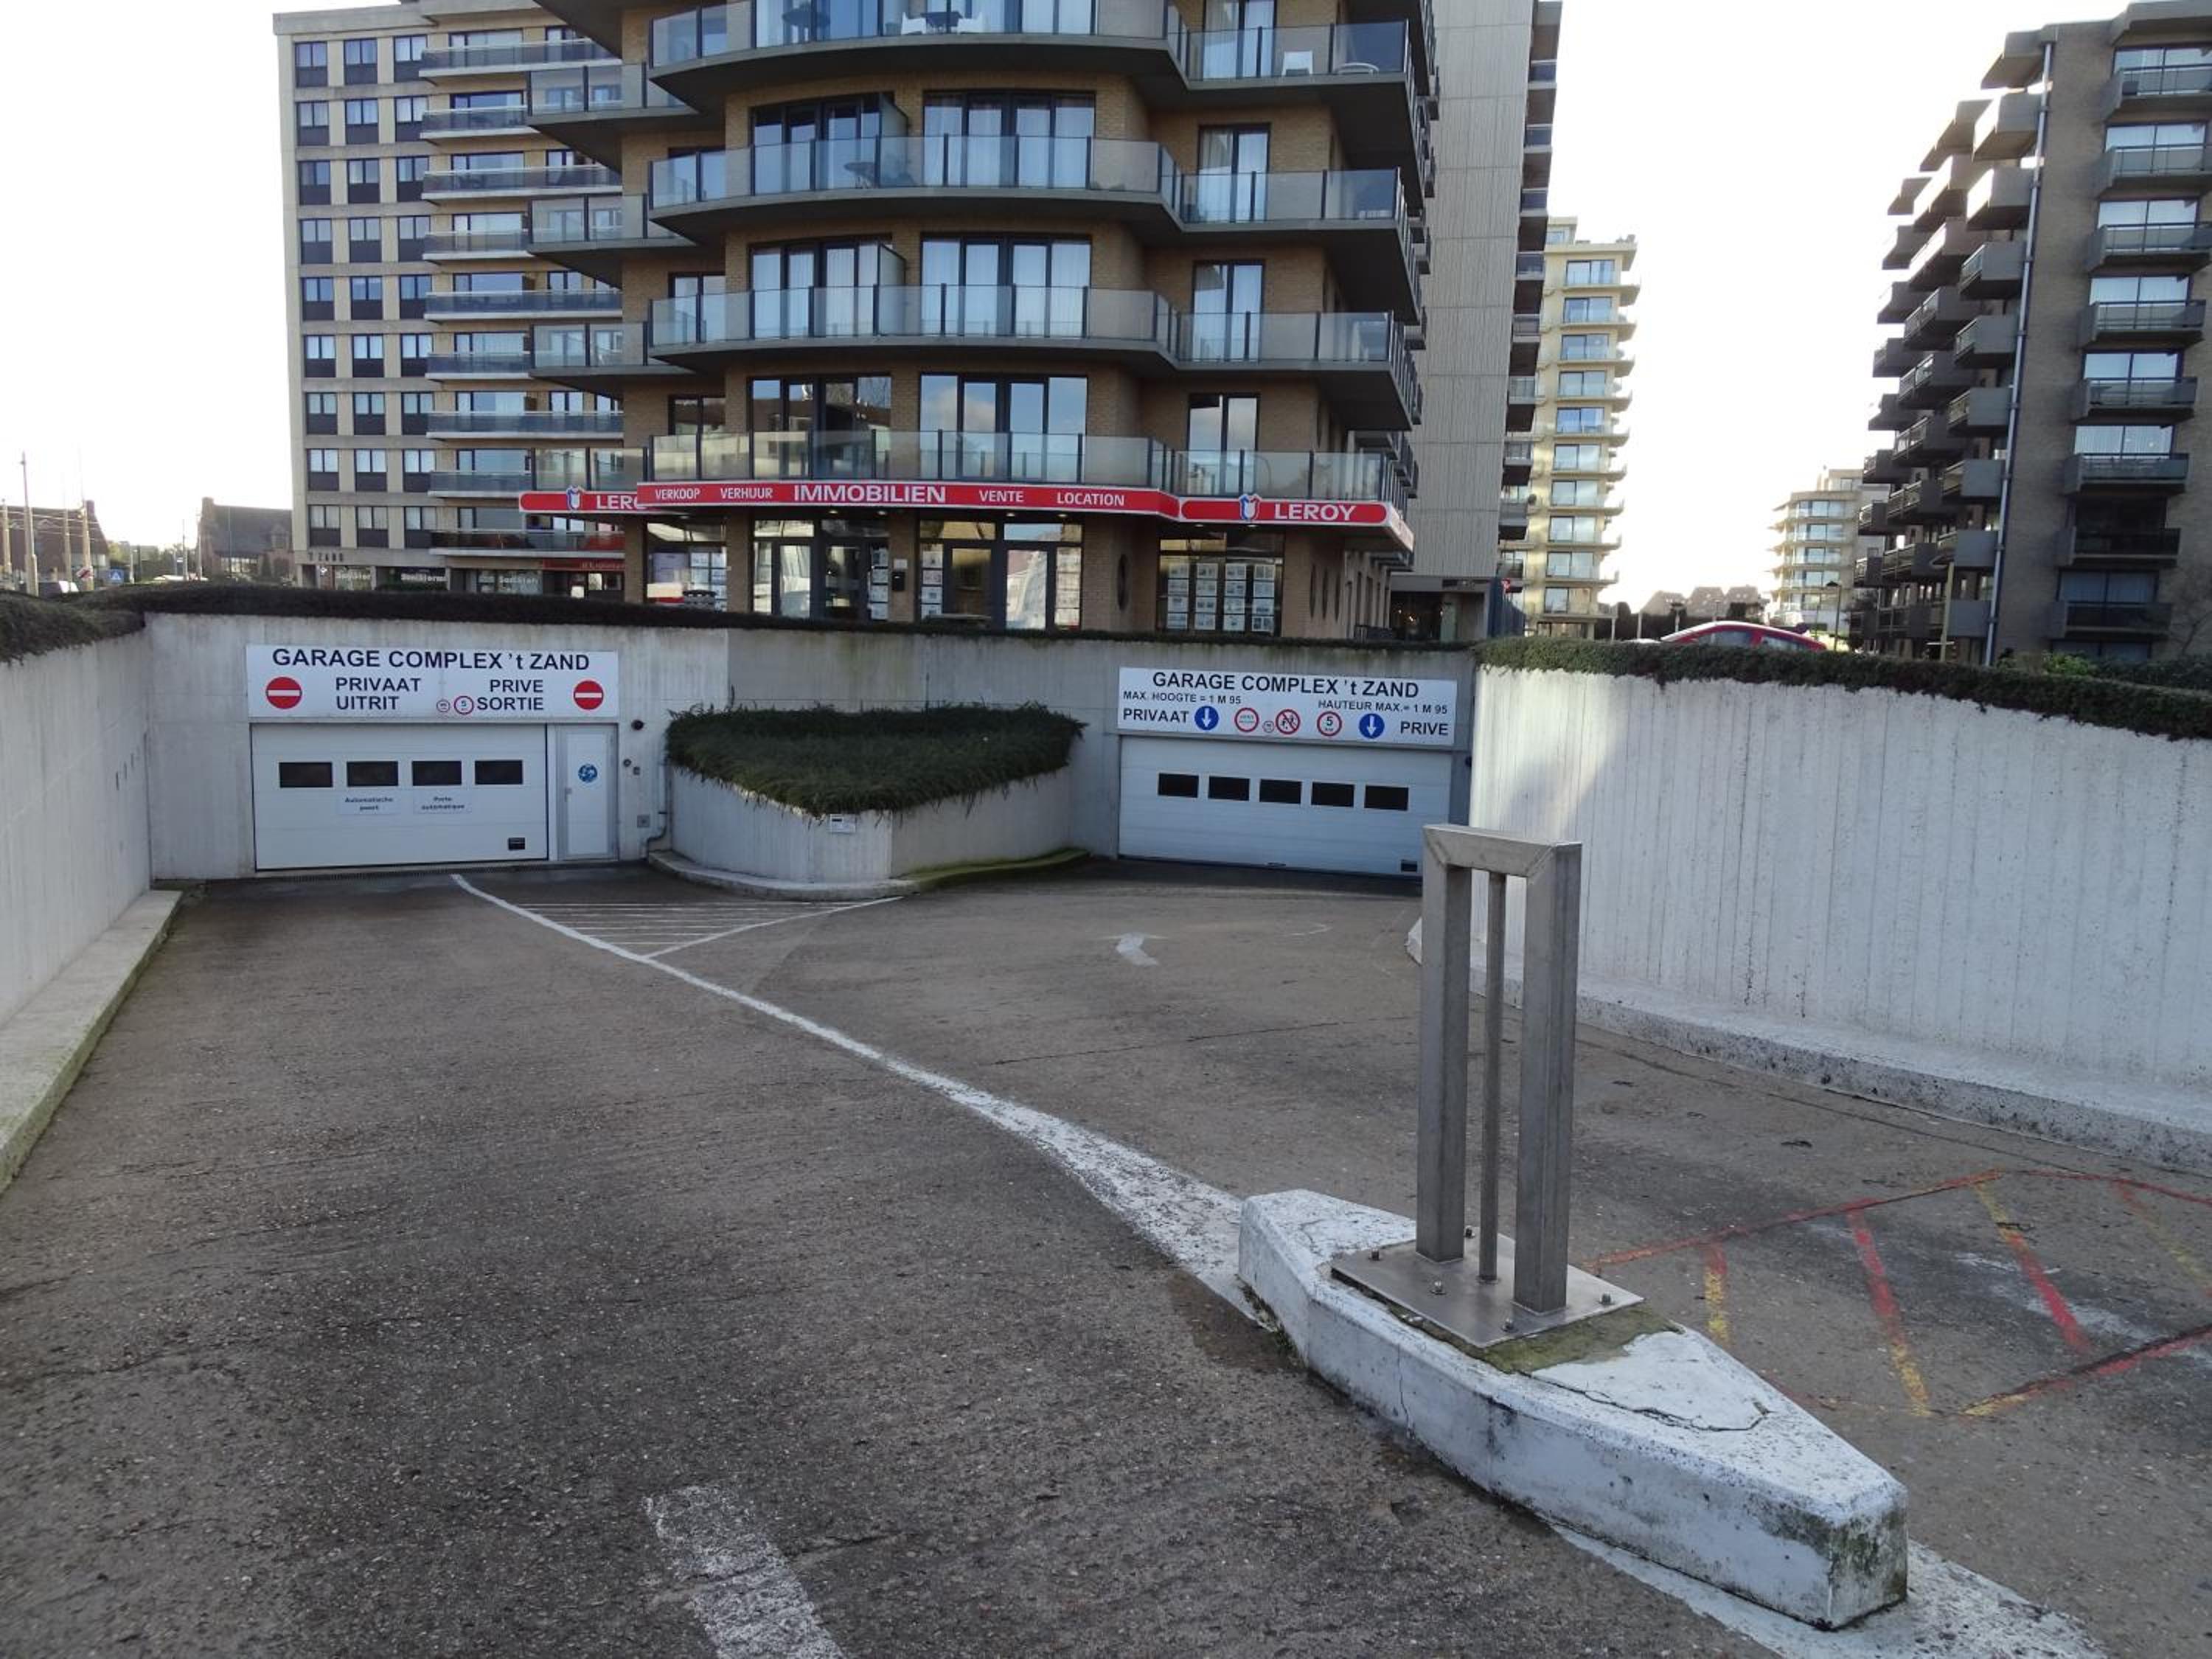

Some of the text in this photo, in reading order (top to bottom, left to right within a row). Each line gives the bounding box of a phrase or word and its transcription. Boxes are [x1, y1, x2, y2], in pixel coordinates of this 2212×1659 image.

[655, 484, 1125, 507] VERKOOP VERHUUR IMMOBILIEN VENTE LOCATION
[1274, 504, 1357, 521] LEROY
[272, 648, 381, 668] GARAGE
[389, 650, 503, 670] COMPLEX
[529, 653, 590, 671] ZAND
[335, 677, 421, 692] PRIVAAT
[490, 679, 543, 694] PRIVE
[1152, 672, 1235, 690] GARAGE
[1242, 675, 1339, 695] COMPLEX
[1362, 681, 1419, 698] ZAND
[336, 695, 400, 711] UITRIT
[476, 697, 544, 711] SORTIE
[1152, 692, 1197, 702] HOOGTE
[1217, 695, 1226, 704] M
[1229, 696, 1242, 704] 95
[1318, 700, 1371, 711] HAUTEUR
[1422, 704, 1431, 713] M
[1434, 705, 1447, 714] 95
[1123, 708, 1189, 723] PRIVAAT
[1326, 716, 1334, 726] 5
[1400, 721, 1449, 735] PRIVE
